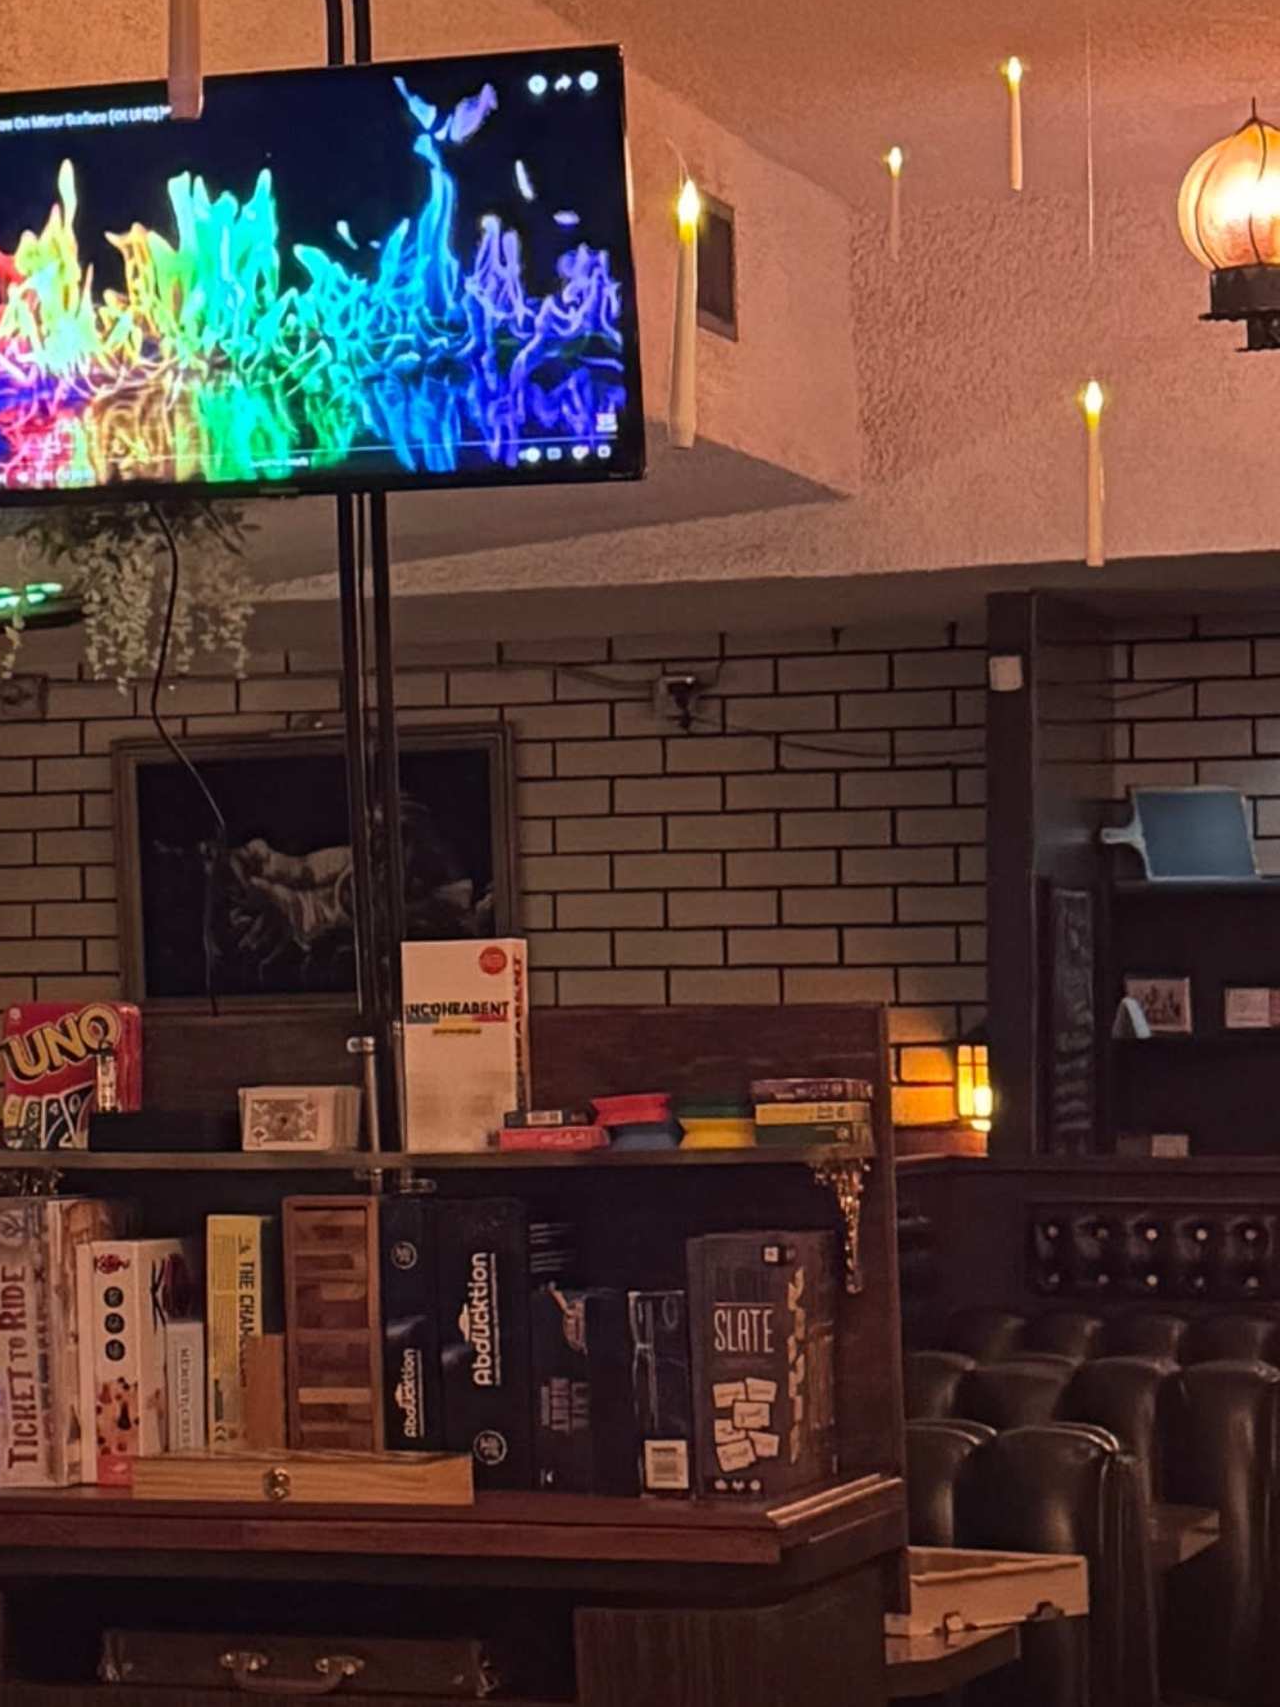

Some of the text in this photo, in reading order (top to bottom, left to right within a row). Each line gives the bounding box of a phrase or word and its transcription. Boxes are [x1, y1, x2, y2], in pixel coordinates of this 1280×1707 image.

[5, 1004, 121, 1081] UNO
[238, 1261, 255, 1290] THE
[9, 1337, 30, 1362] TO
[714, 1308, 774, 1353] SLATE
[7, 1365, 39, 1469] TICKET
